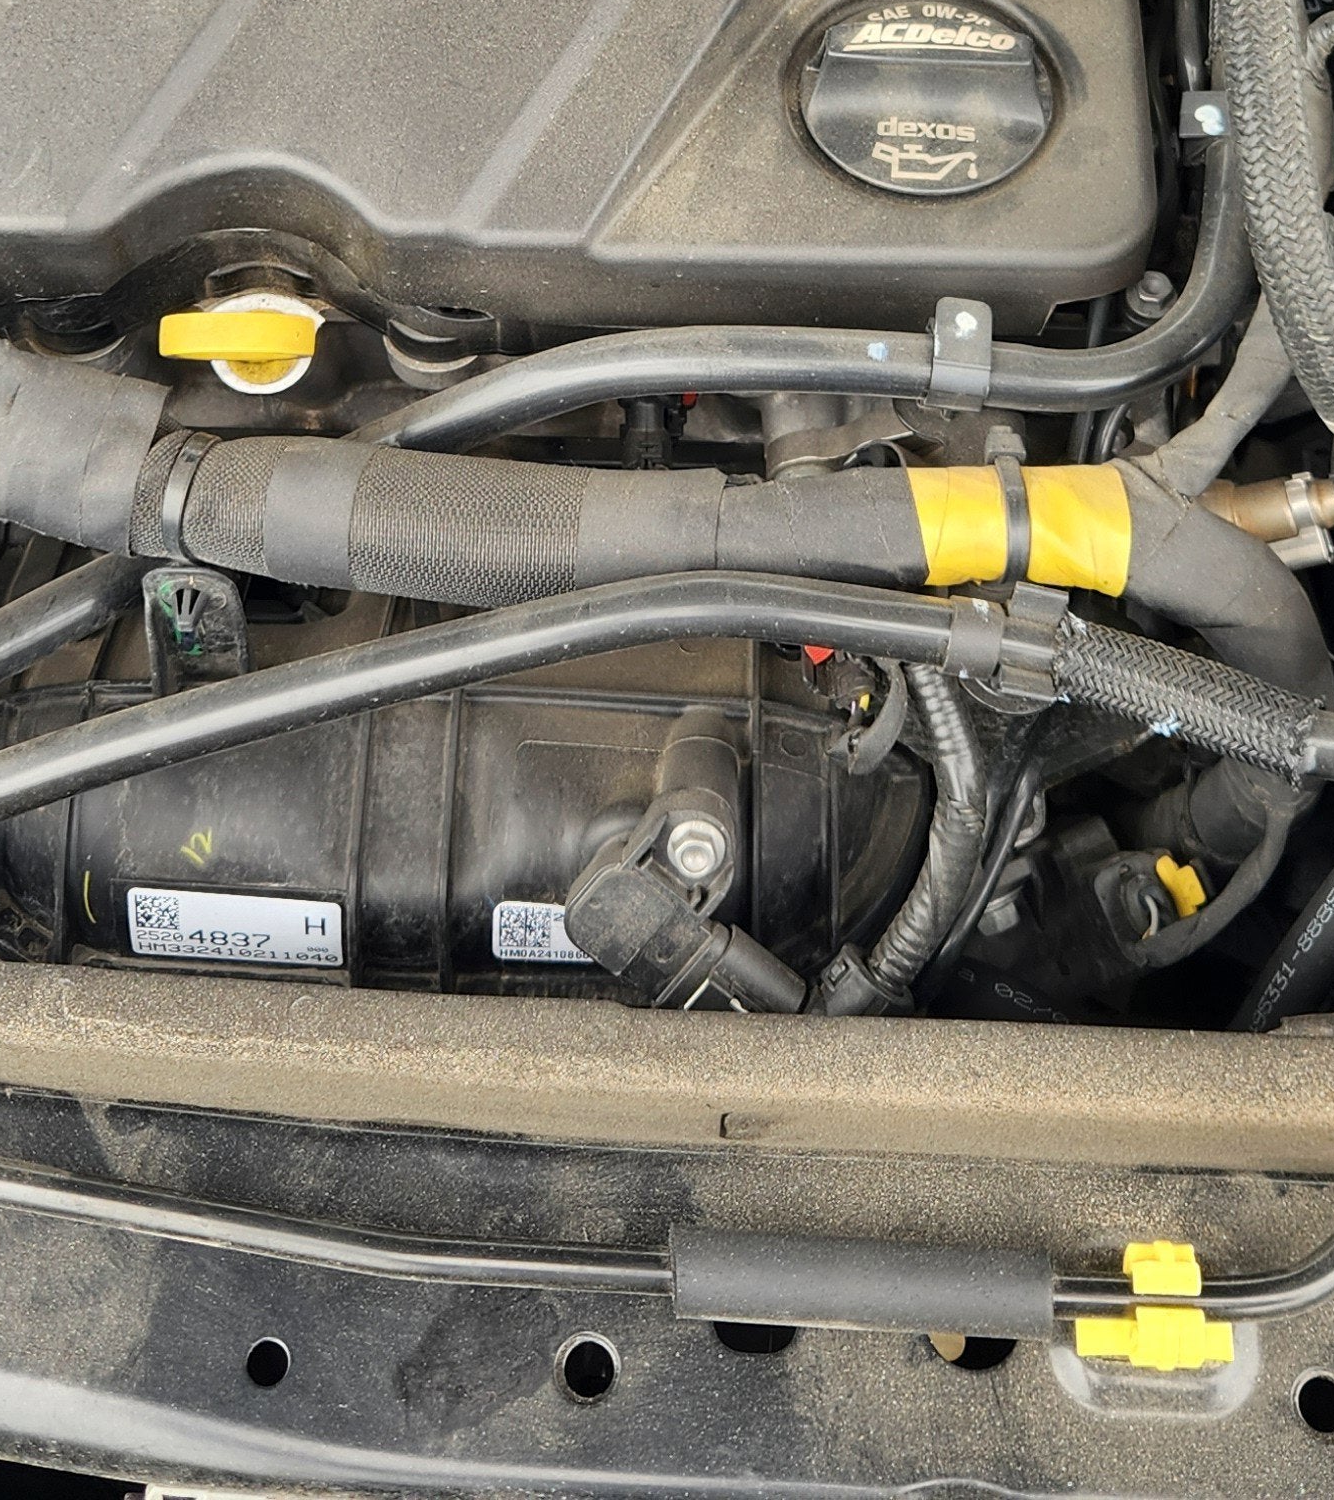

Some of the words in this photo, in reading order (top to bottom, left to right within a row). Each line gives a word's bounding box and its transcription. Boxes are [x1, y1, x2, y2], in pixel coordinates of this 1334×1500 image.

[867, 5, 912, 22] SAE
[850, 22, 1016, 51] ACDelco
[876, 116, 977, 143] dexos
[304, 916, 327, 937] H
